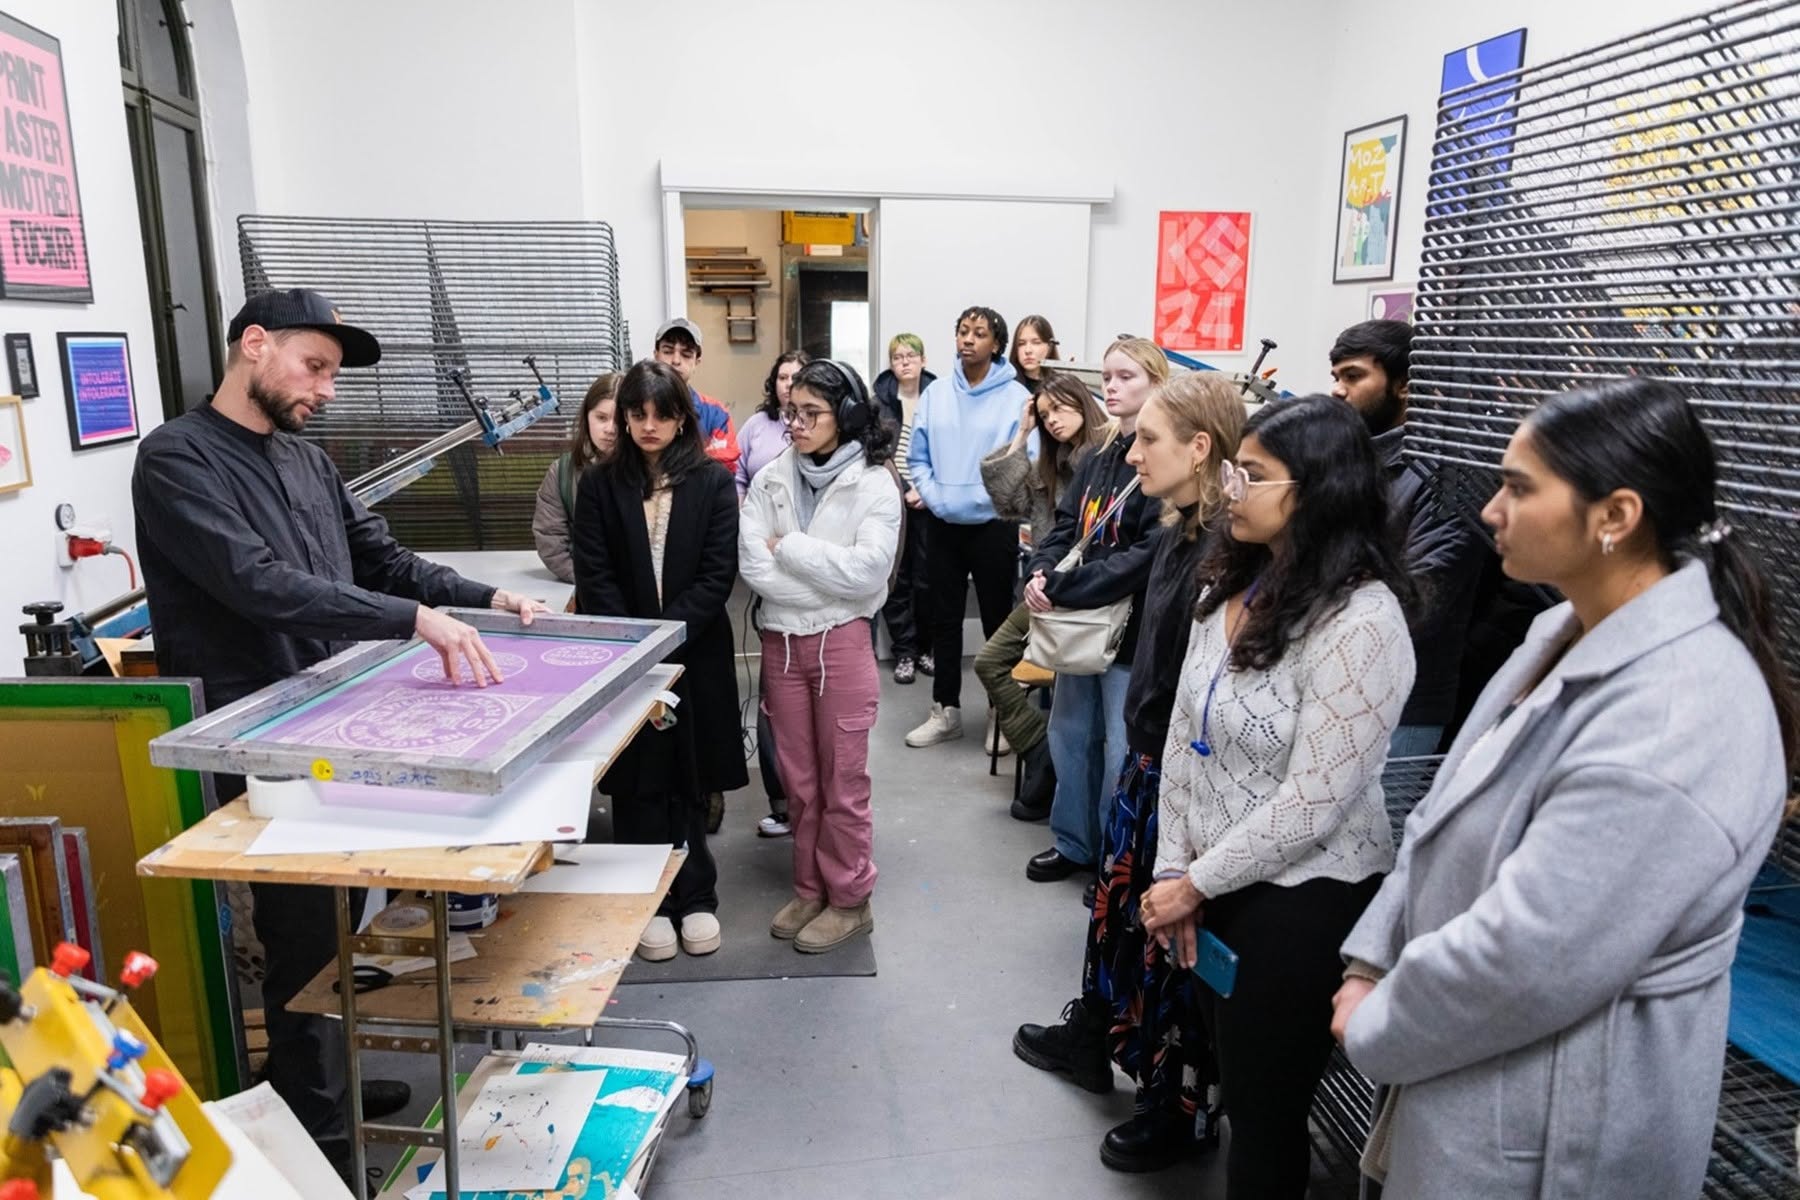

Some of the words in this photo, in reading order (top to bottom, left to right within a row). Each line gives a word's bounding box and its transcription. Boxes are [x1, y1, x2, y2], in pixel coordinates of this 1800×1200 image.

[2, 106, 64, 166] ASTER
[0, 162, 73, 217] MOTHER
[10, 219, 77, 270] FUCKER
